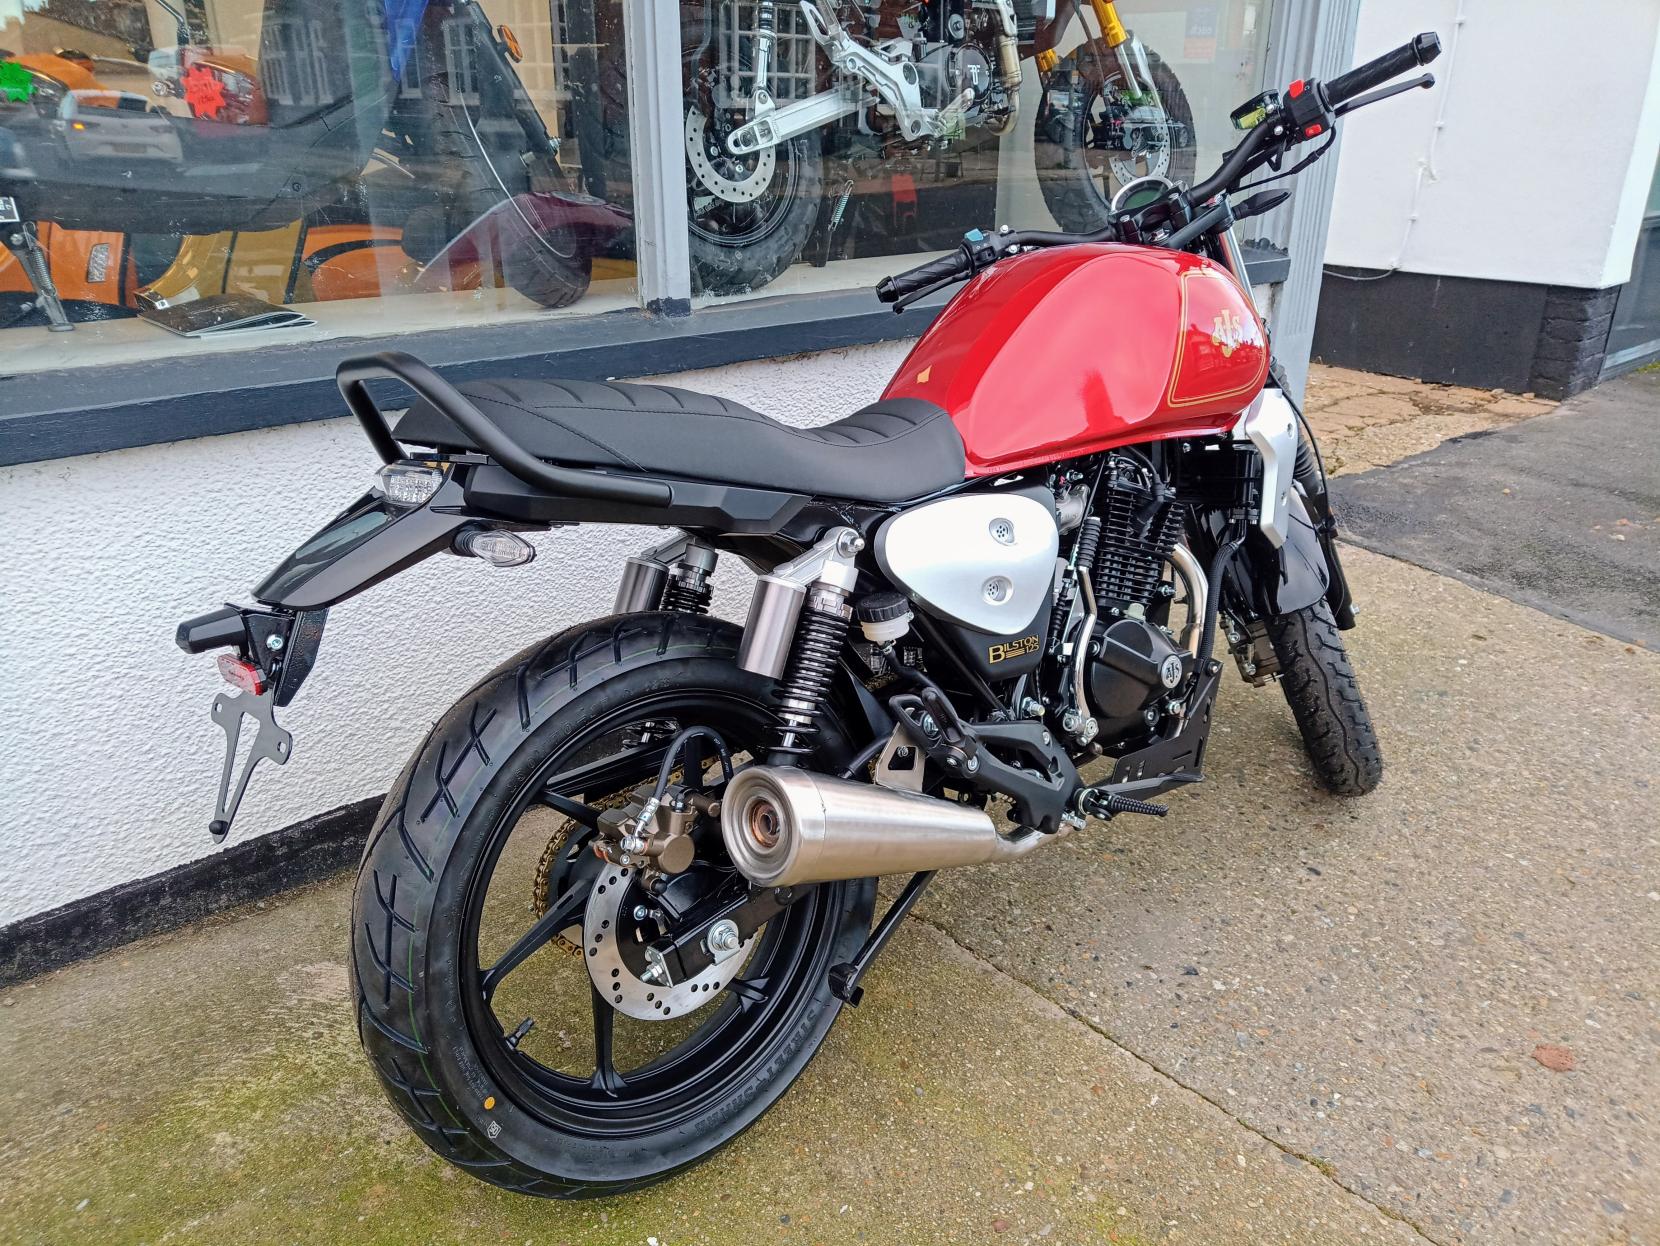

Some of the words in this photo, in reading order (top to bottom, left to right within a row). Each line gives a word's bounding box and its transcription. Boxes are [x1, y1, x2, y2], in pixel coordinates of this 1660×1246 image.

[1212, 309, 1241, 358] AJS
[988, 634, 1039, 664] BILSTON
[1025, 642, 1040, 653] 125
[1165, 662, 1180, 684] AJS
